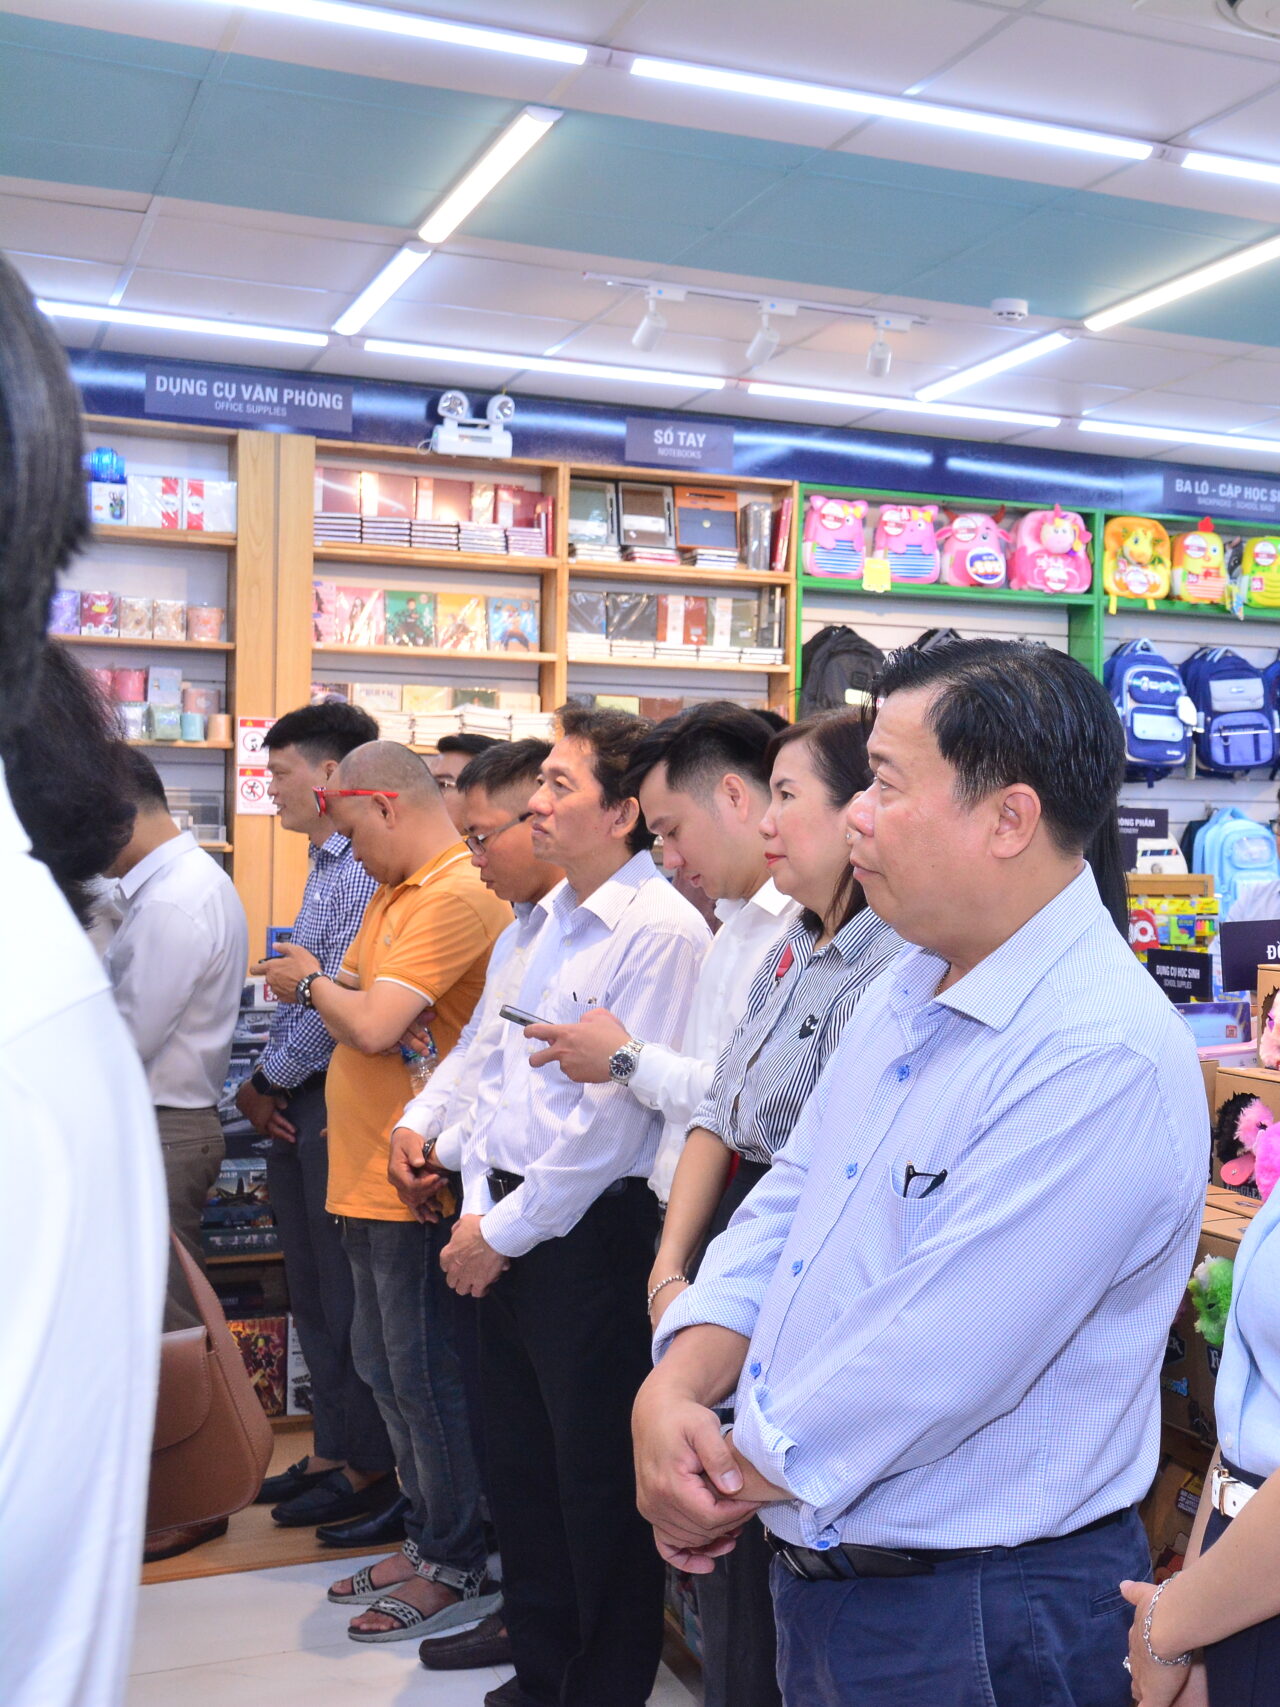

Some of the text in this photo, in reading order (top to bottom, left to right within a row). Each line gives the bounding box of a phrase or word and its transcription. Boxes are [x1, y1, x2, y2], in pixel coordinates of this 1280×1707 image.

[156, 375, 344, 410] DỤNG CỤ VĂN PHÒNG
[215, 401, 287, 417] OFFICE SUPPLIES
[677, 431, 706, 448] TAY
[1175, 479, 1192, 493] BA
[1188, 968, 1200, 979] SINH
